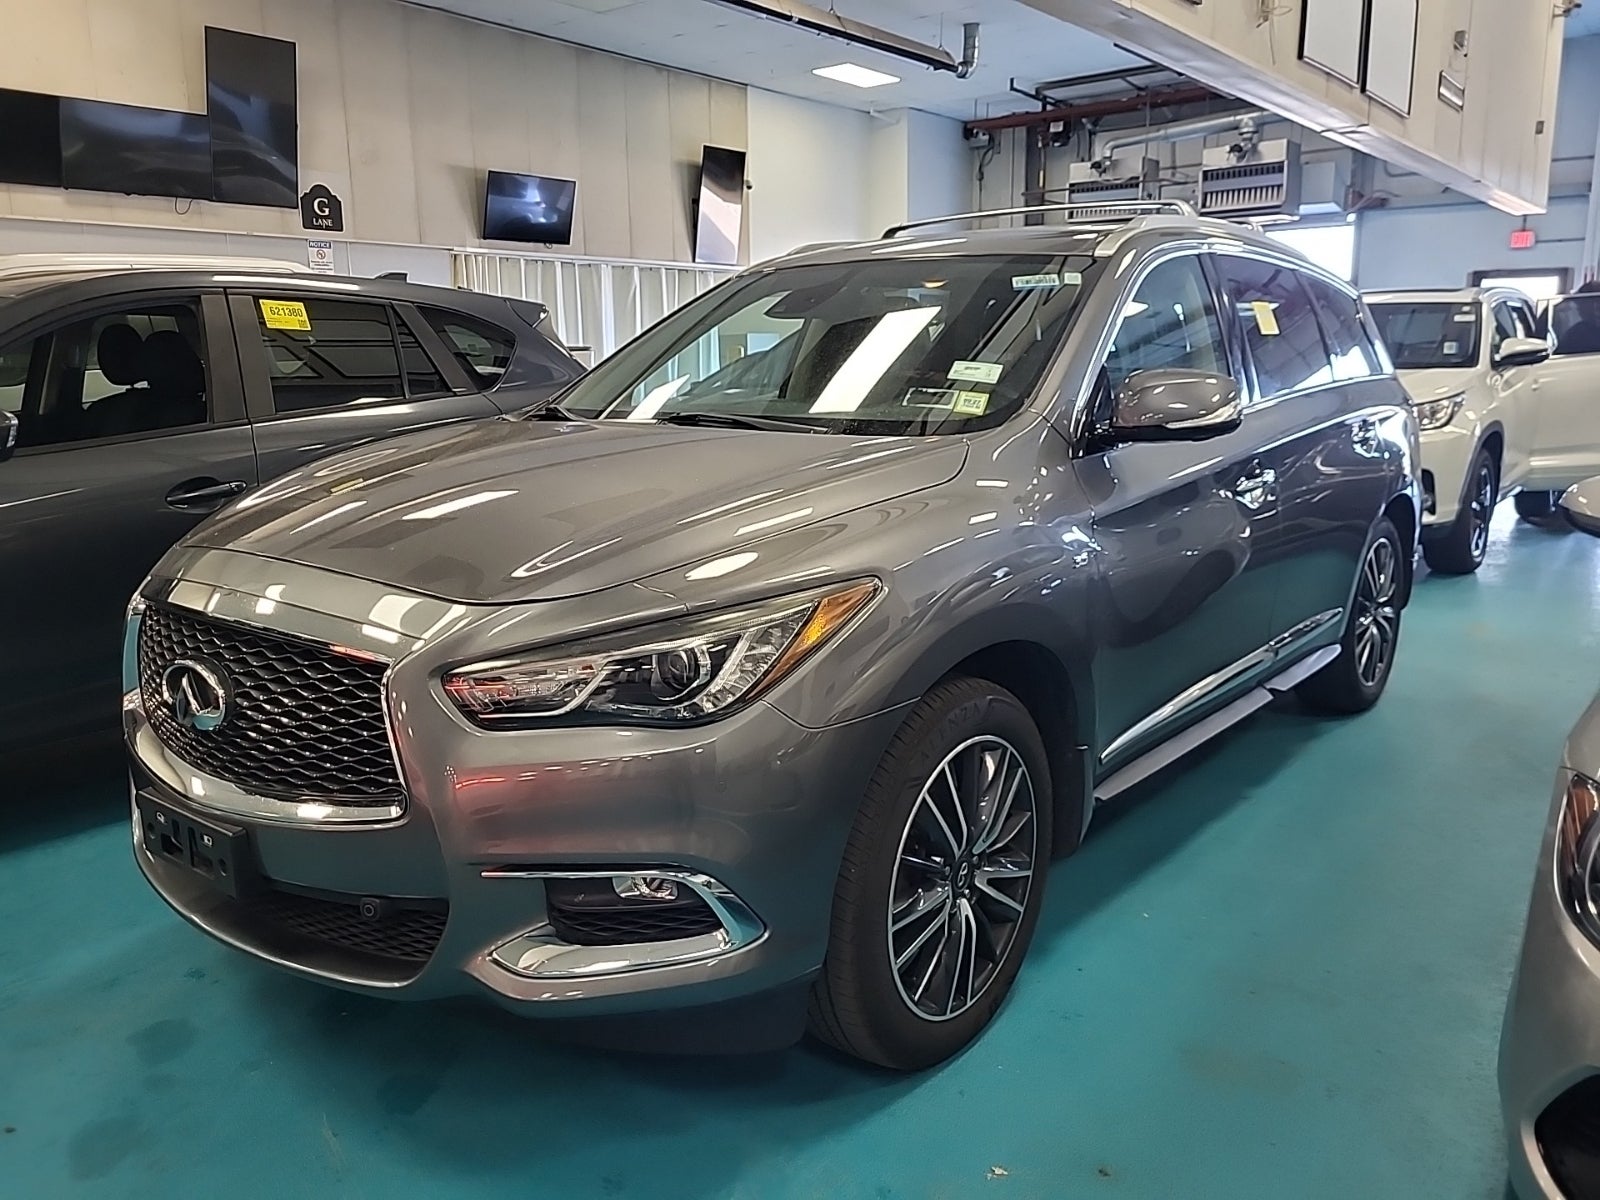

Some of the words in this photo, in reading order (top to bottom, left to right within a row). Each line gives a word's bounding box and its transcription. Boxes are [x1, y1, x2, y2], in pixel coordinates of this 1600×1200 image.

[313, 197, 330, 216] G
[312, 217, 334, 228] LANE
[269, 306, 304, 318] 621380
